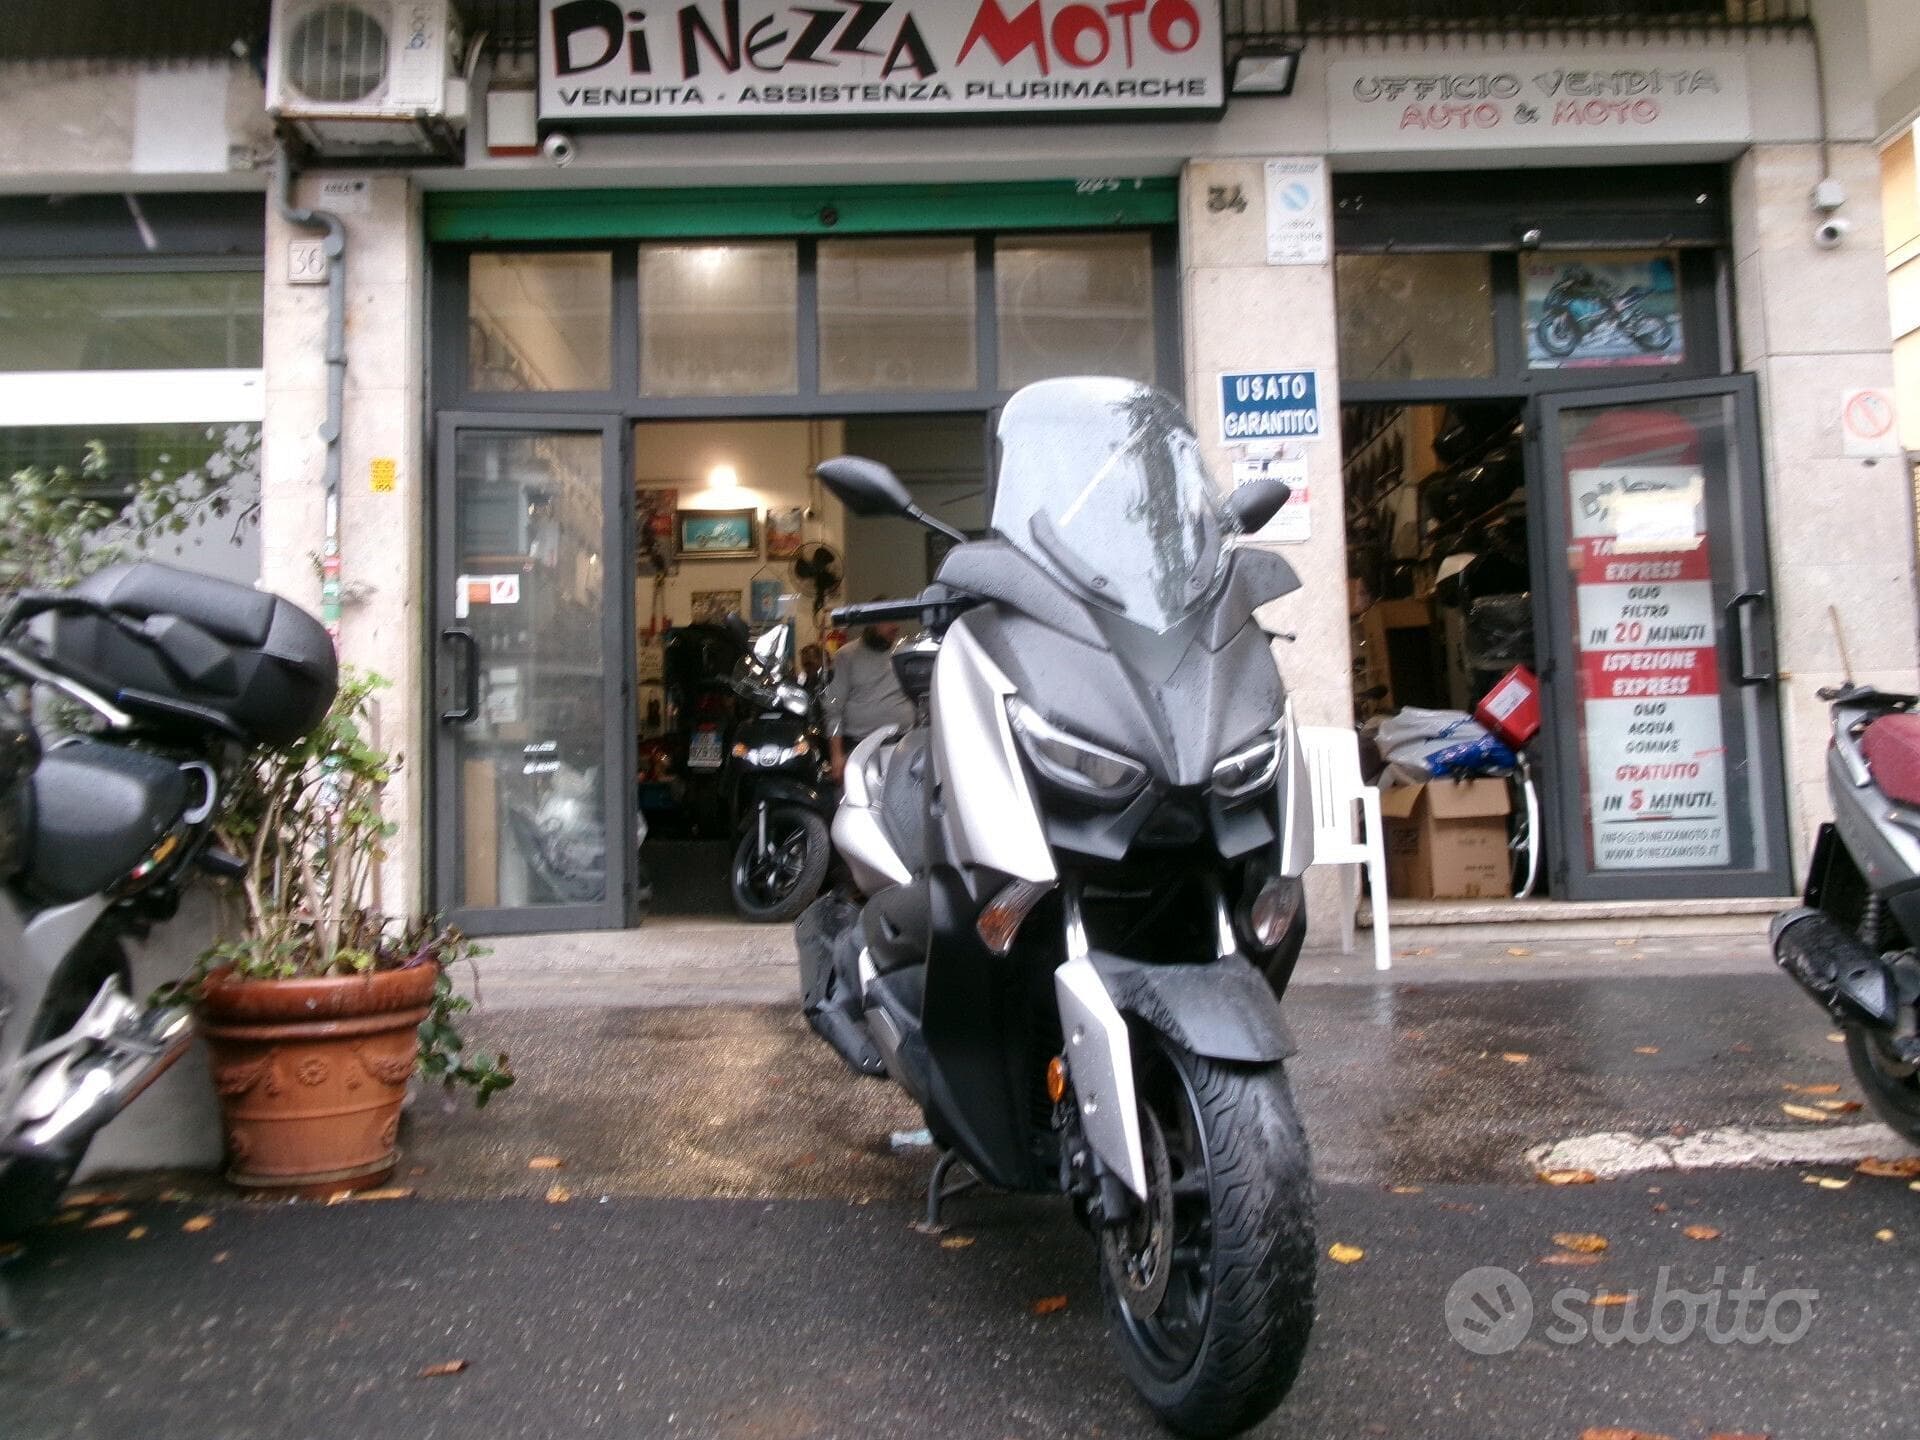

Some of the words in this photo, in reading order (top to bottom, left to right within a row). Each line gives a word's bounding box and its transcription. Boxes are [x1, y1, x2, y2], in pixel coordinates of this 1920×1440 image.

[955, 0, 1201, 78] MOTO
[557, 86, 705, 107] VENDITA
[737, 82, 951, 105] ASSISTENZA
[964, 77, 1209, 101] PLURIMARCHE
[1352, 73, 1523, 103] UFFICIO
[1532, 69, 1722, 98] VENDITA
[1400, 102, 1501, 130] AUTO
[1551, 99, 1663, 127] MOTO
[1236, 374, 1307, 402] USATO
[1225, 408, 1318, 437] GARANTITO
[1621, 604, 1670, 618] FILTRO
[1590, 629, 1609, 644] IN
[1615, 622, 1642, 643] 20
[1645, 624, 1707, 646] MINUTI
[1602, 651, 1697, 672] ISPEZIONE
[1612, 676, 1691, 696] EXPRESS
[1628, 720, 1674, 735] ACQUA
[1625, 739, 1681, 753] GOMME
[1615, 762, 1700, 781] GRATUITO
[1603, 795, 1623, 811] IN
[1628, 789, 1644, 811] 5
